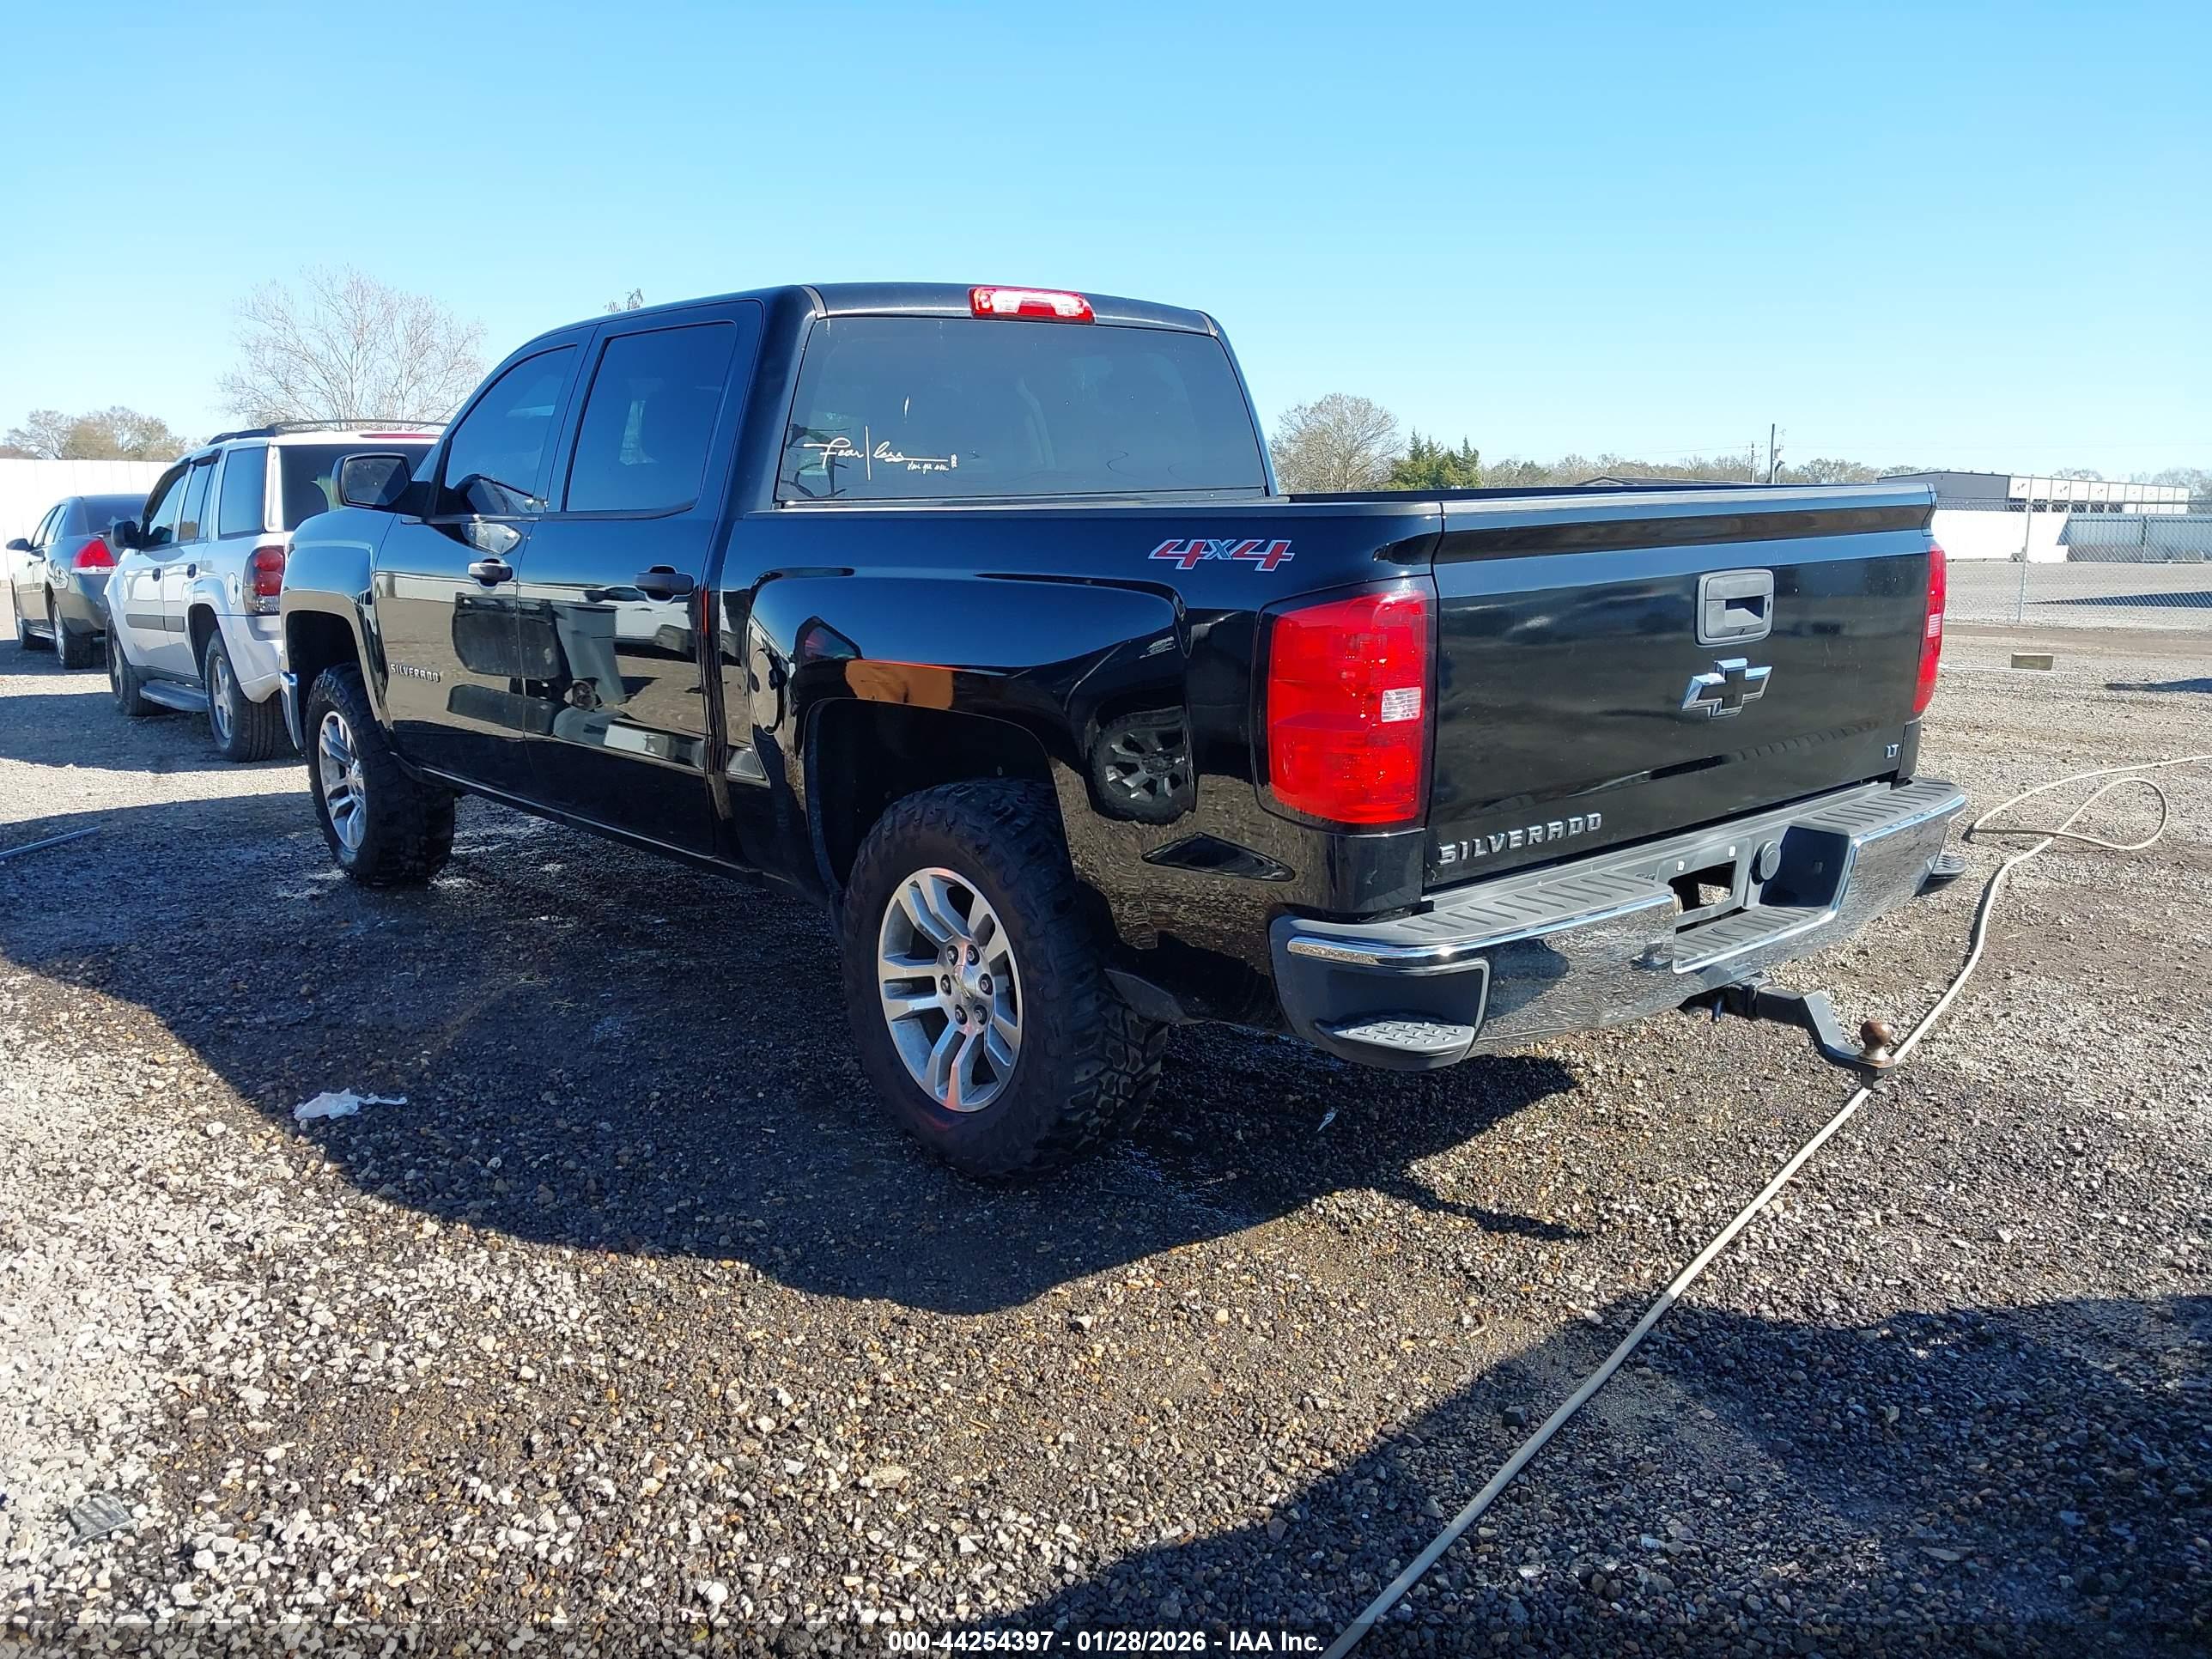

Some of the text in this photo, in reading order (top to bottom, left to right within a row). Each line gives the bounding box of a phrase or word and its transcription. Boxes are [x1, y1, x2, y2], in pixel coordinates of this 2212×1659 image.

[390, 663, 441, 683] SILVERADO
[1886, 744, 1899, 759] LT
[1437, 811, 1602, 866] SILVERADO
